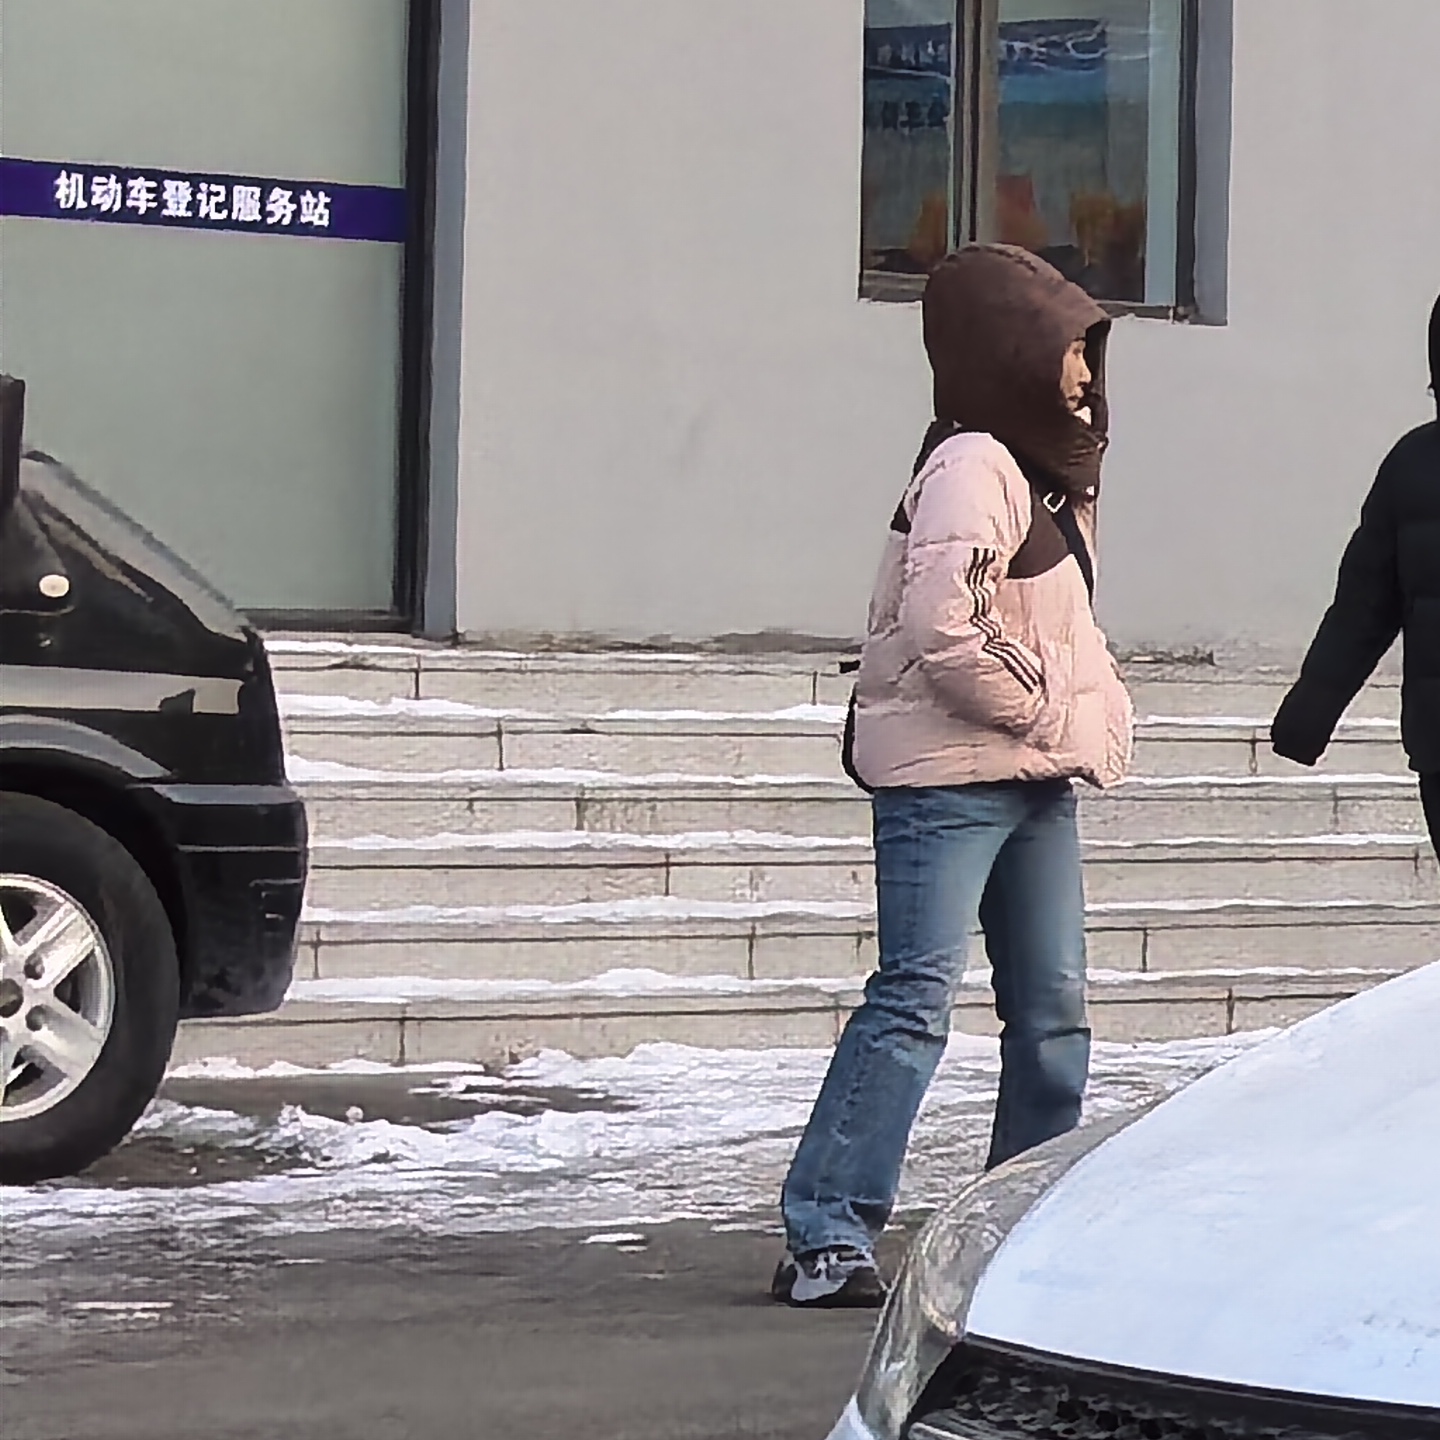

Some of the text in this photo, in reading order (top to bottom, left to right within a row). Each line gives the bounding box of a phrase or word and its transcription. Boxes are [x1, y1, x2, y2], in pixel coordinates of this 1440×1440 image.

[53, 169, 332, 227] 机动车登记服务站
